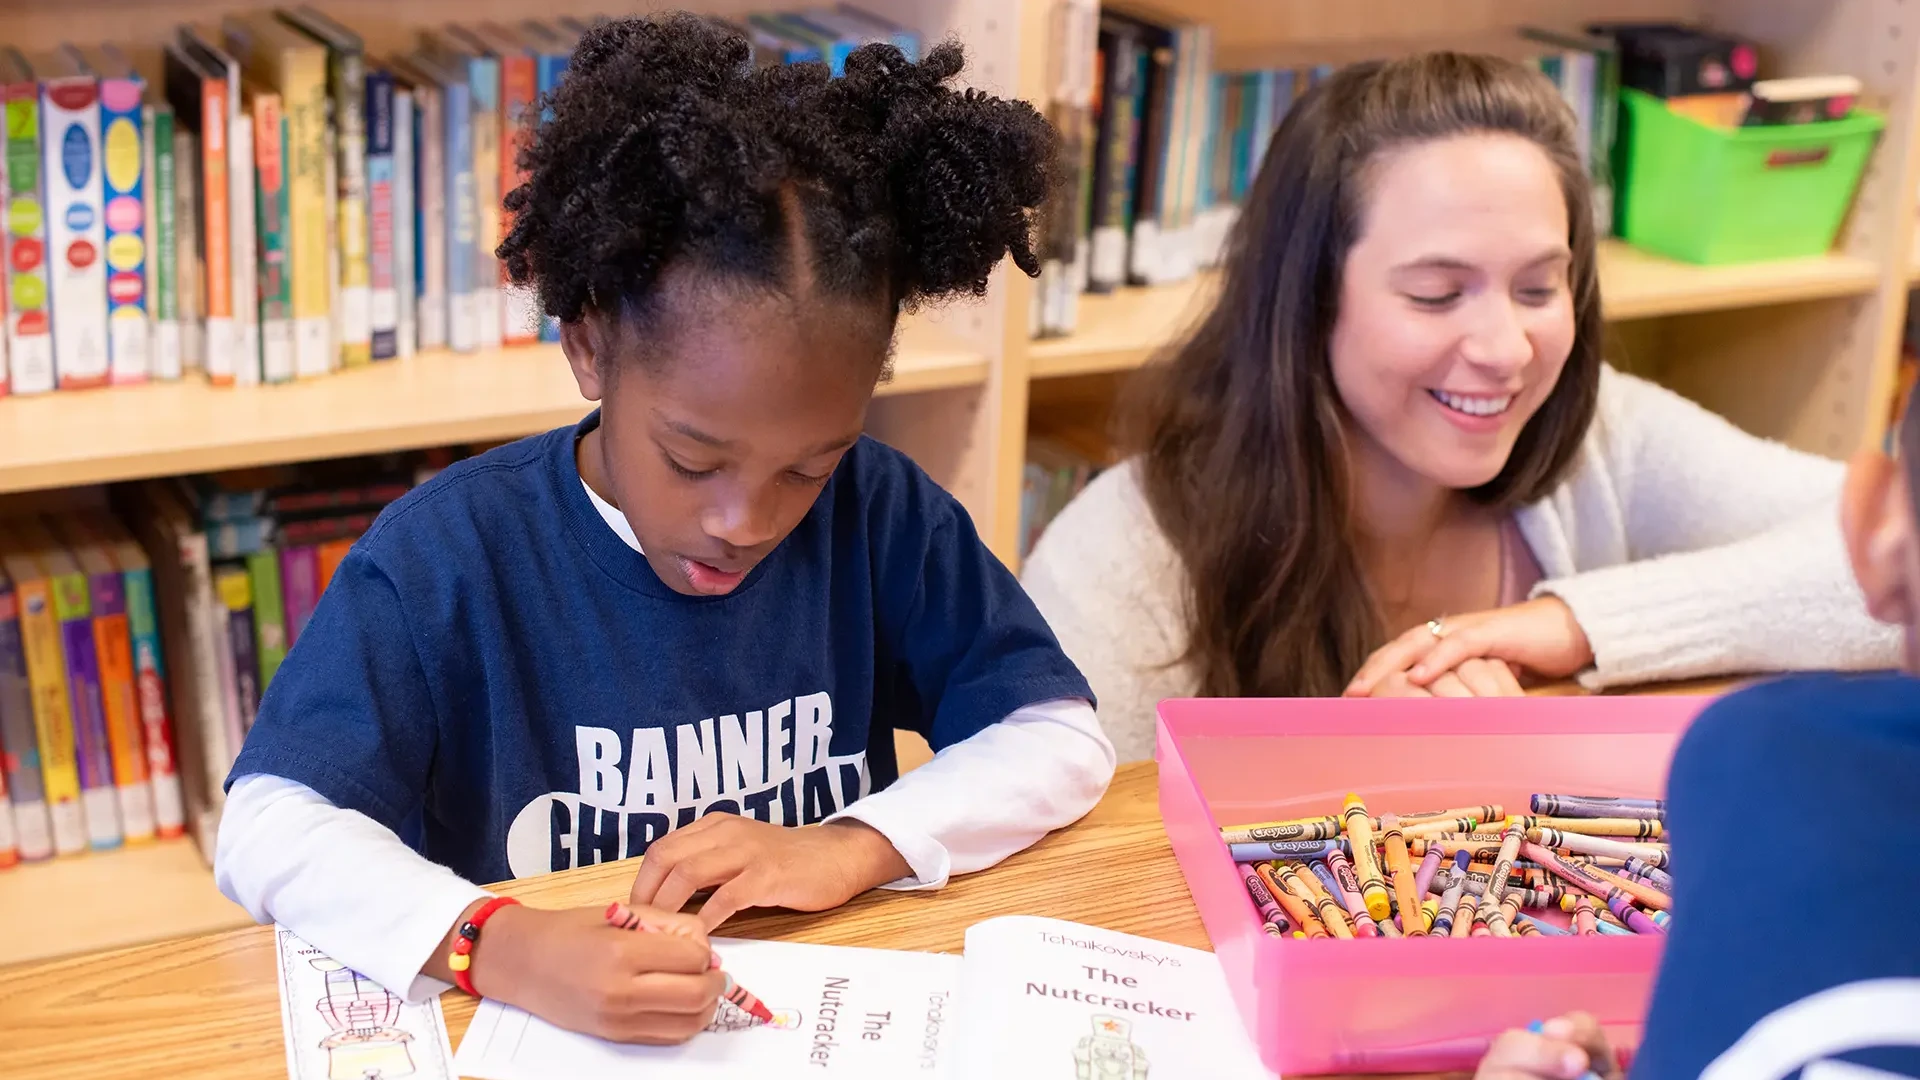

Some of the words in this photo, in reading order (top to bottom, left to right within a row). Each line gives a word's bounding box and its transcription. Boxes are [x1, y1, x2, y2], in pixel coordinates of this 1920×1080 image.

[575, 691, 833, 807] BANNER
[1253, 824, 1298, 839] Crayola
[1272, 840, 1320, 852] Crayola
[1248, 876, 1272, 903] Crayola
[1038, 931, 1182, 967] Tchaikovsky's
[1082, 965, 1138, 988] The
[1026, 982, 1197, 1021] Nutcracker
[810, 977, 850, 1067] Nutcracker
[862, 1011, 891, 1041] The
